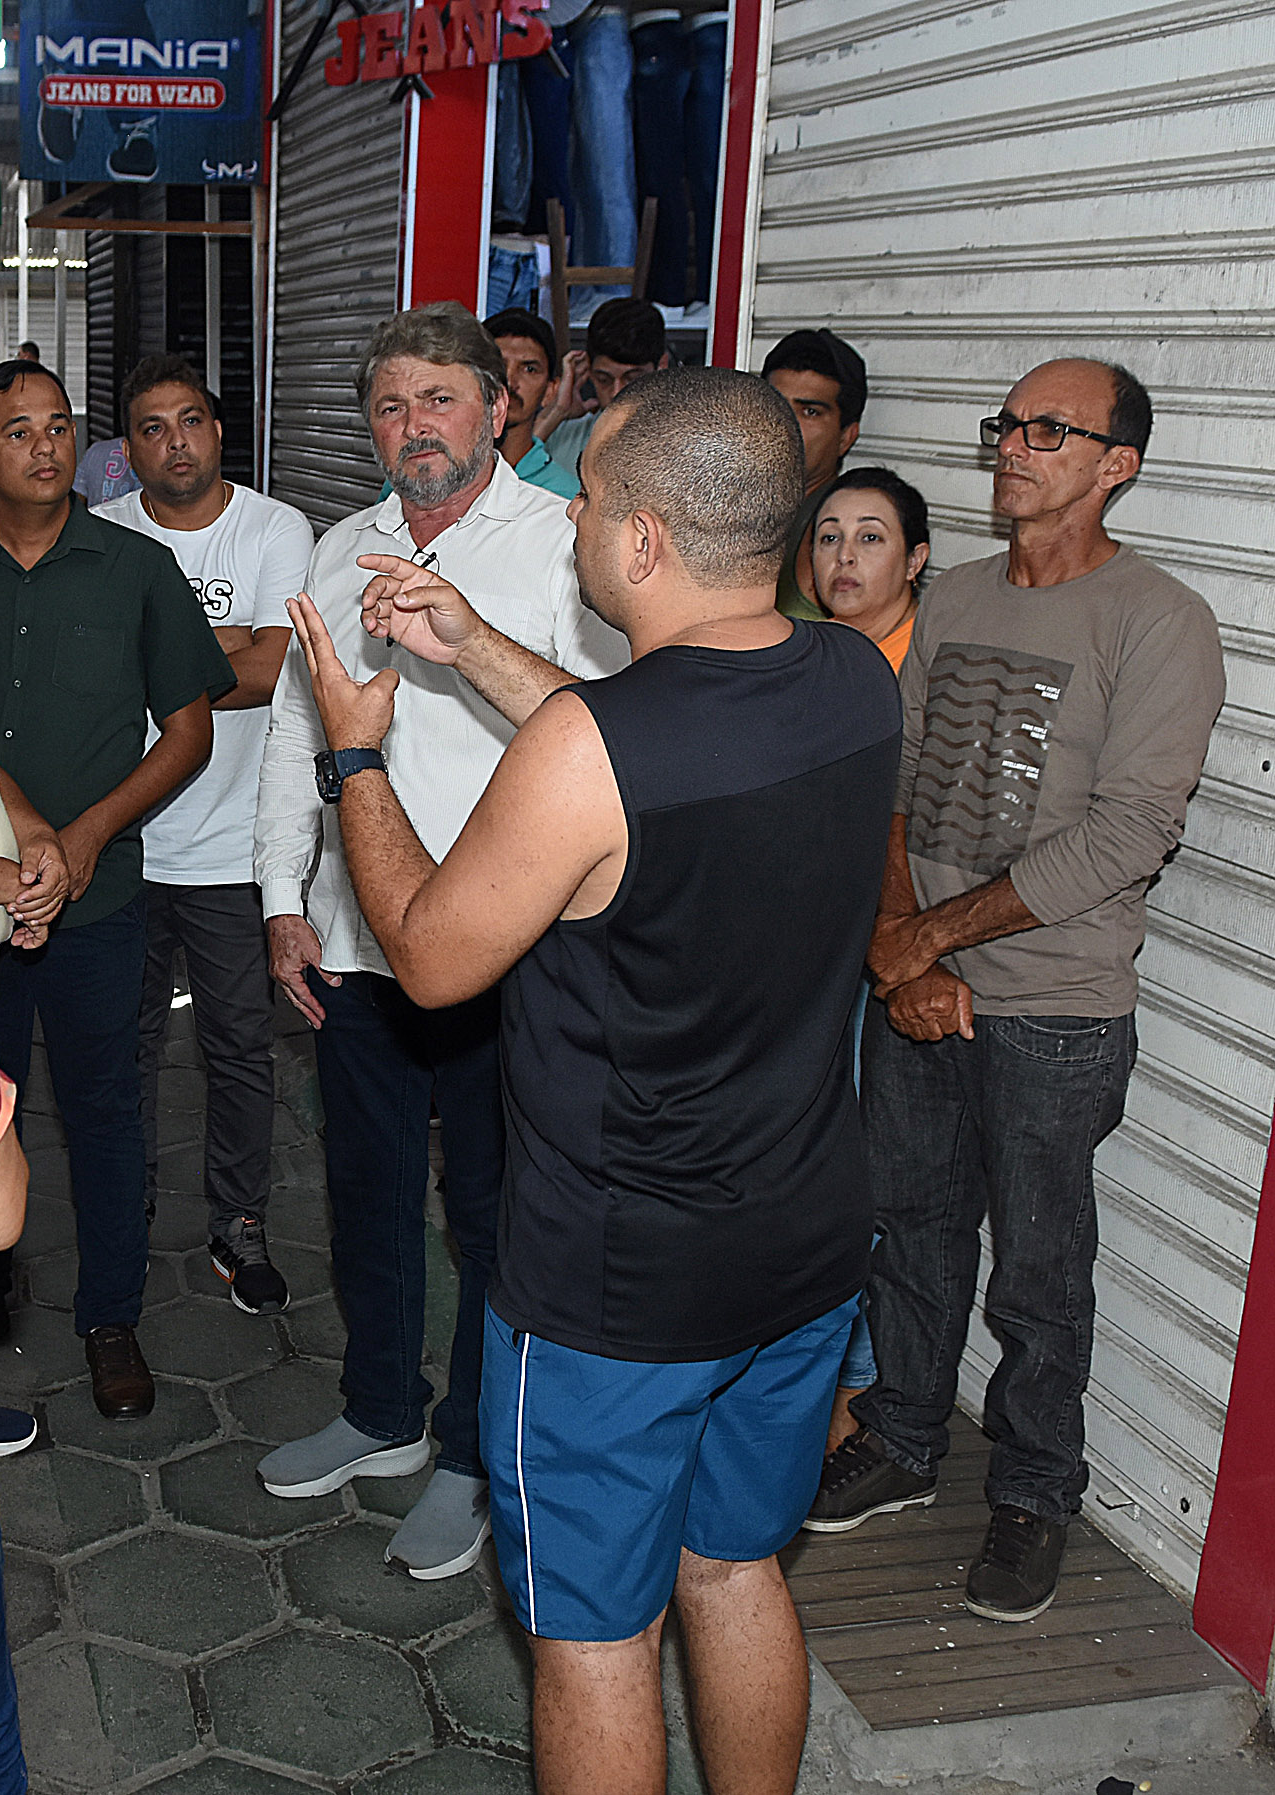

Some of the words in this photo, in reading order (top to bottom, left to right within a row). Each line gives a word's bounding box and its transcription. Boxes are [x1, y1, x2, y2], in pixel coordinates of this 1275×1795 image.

[325, 0, 553, 86] JEANS
[45, 82, 111, 102] JEANS
[115, 83, 152, 104] FOR
[156, 85, 217, 105] WEAR
